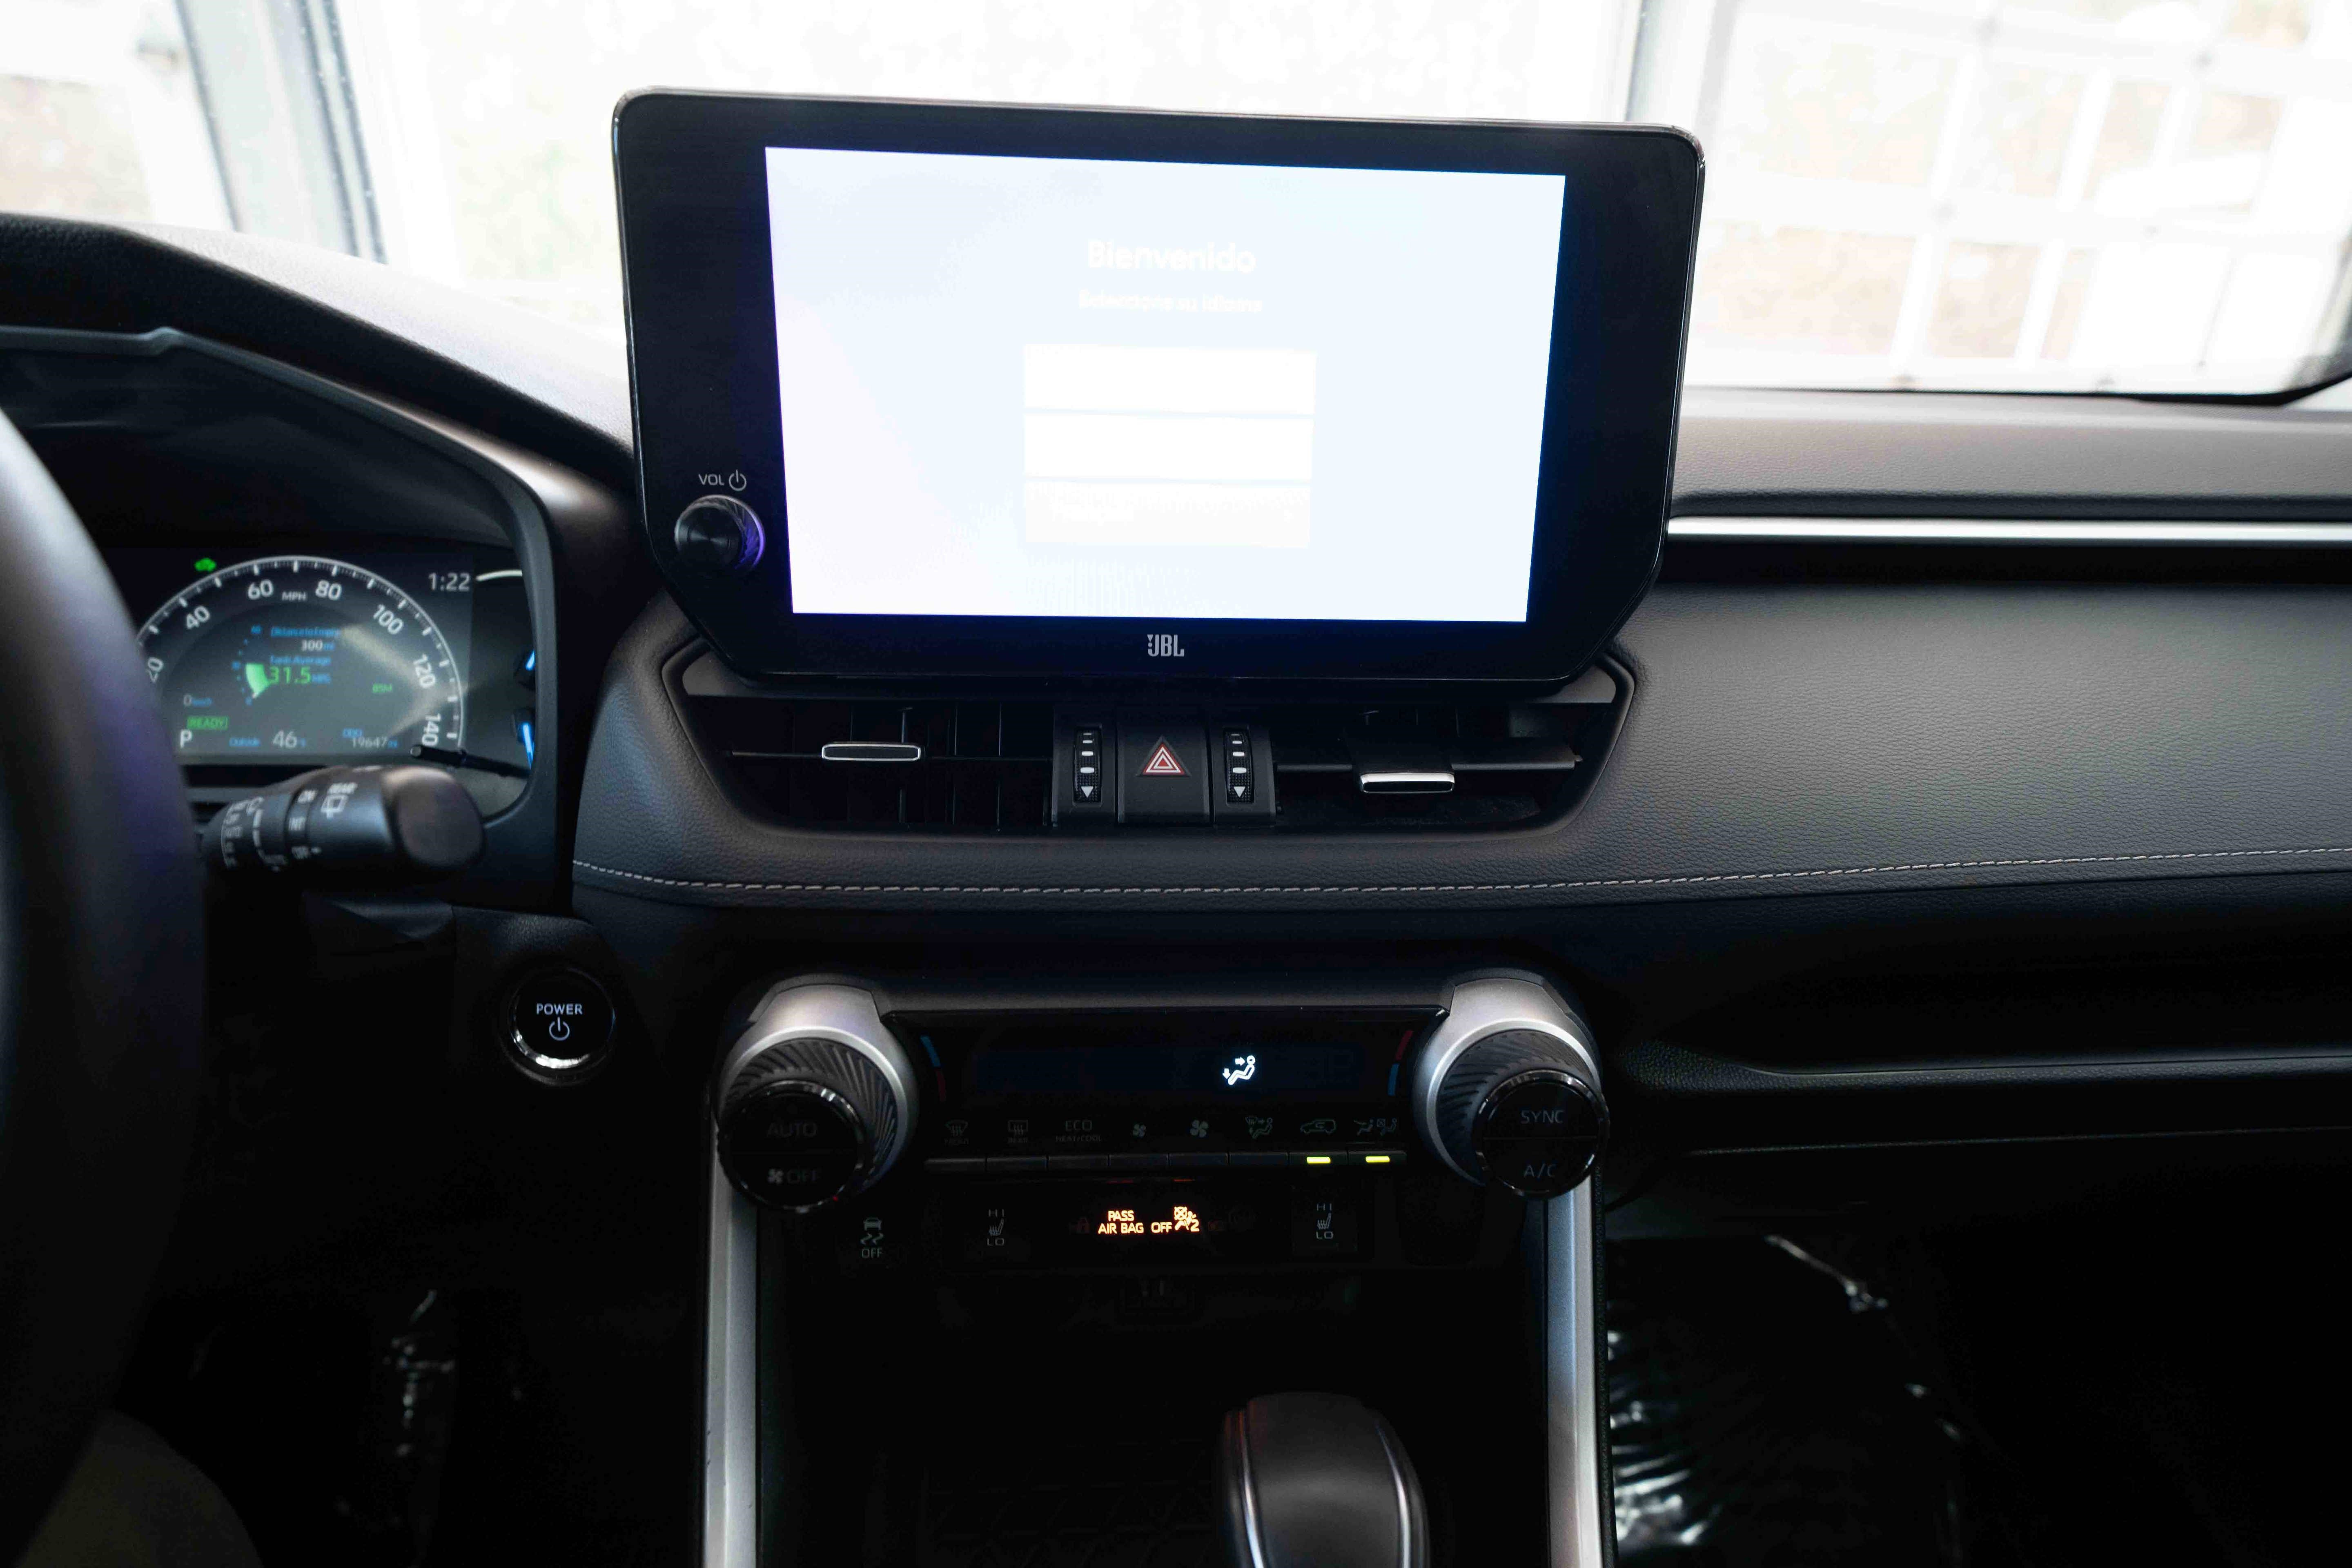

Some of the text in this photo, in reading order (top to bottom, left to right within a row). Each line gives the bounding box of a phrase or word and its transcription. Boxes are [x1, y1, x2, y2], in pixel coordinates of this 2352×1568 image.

[1087, 238, 1257, 274] Bienvenido
[699, 474, 724, 486] VOL
[247, 579, 274, 600] 60
[428, 572, 471, 592] 1:22
[282, 592, 306, 601] MPH
[315, 579, 342, 601] 80
[185, 605, 210, 630] 40
[373, 604, 404, 635] 100
[1147, 634, 1185, 657] JBL
[269, 666, 311, 684] 31.5
[412, 654, 436, 688] 120
[421, 713, 441, 747] 140
[180, 729, 193, 748] P
[272, 730, 297, 748] 46
[536, 1003, 583, 1015] POWER
[1521, 1109, 1565, 1123] SYNC
[765, 1122, 818, 1138] AUTO
[1065, 1119, 1093, 1131] ECO
[1523, 1163, 1556, 1178] A/C
[988, 1209, 1005, 1217] HI
[1316, 1203, 1332, 1211] HI
[1108, 1210, 1134, 1222] PASS
[1098, 1223, 1118, 1234] AIR
[1121, 1222, 1144, 1234] BAG
[1151, 1221, 1172, 1233] OFF
[1316, 1231, 1334, 1239] LO
[986, 1238, 1005, 1247] LO
[861, 1247, 883, 1258] OFF
